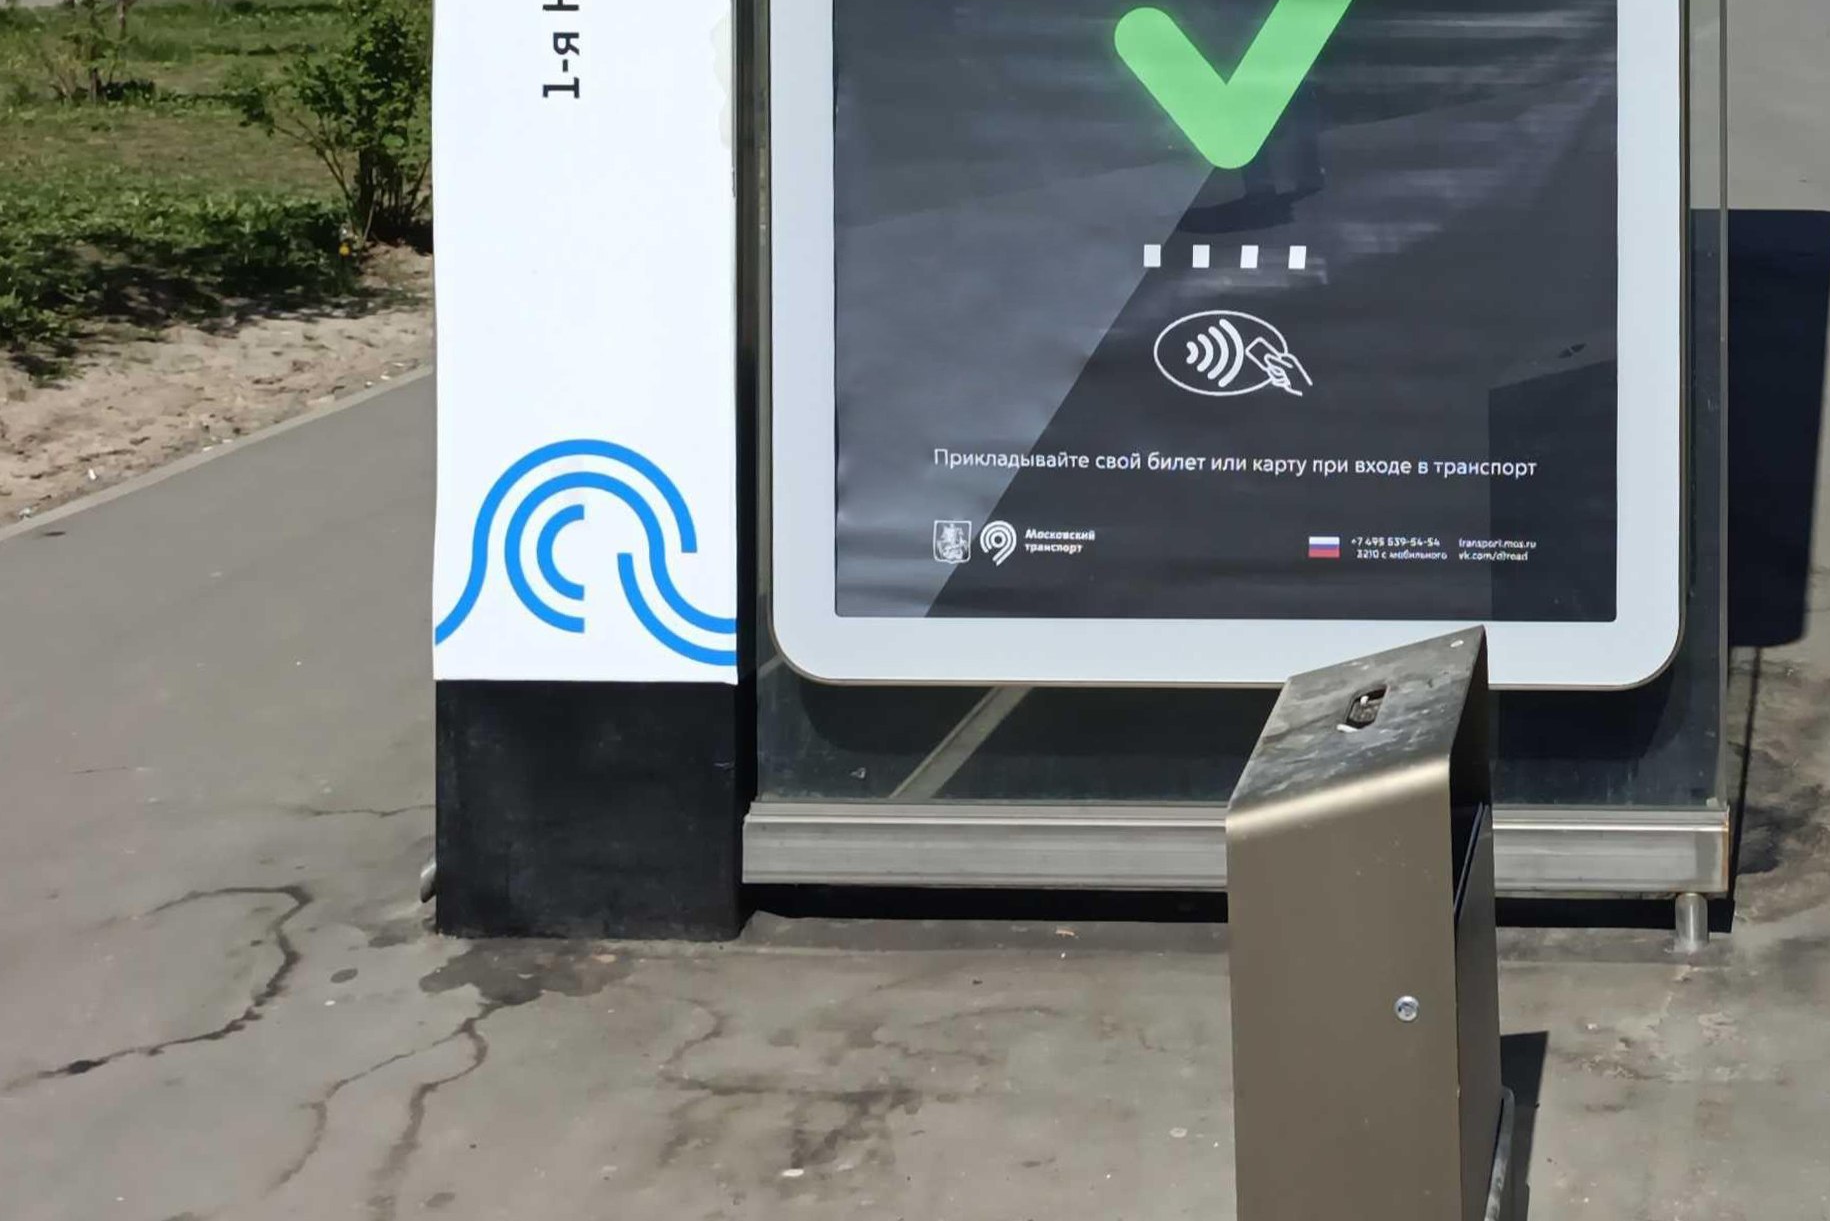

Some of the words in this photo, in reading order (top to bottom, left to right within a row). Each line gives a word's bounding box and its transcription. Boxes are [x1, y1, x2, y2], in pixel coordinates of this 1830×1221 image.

[542, 32, 580, 98] 1-я
[934, 448, 1089, 470] Прикладывайте
[1096, 451, 1141, 470] свой
[1147, 451, 1206, 471] билет
[1211, 456, 1247, 471] или
[1253, 457, 1307, 477] карту
[1312, 458, 1348, 477] при
[1355, 459, 1412, 476] входе
[1418, 460, 1429, 474] в
[1433, 460, 1538, 478] транспорт
[1025, 528, 1096, 541] Московский
[1025, 543, 1084, 555] транспорт
